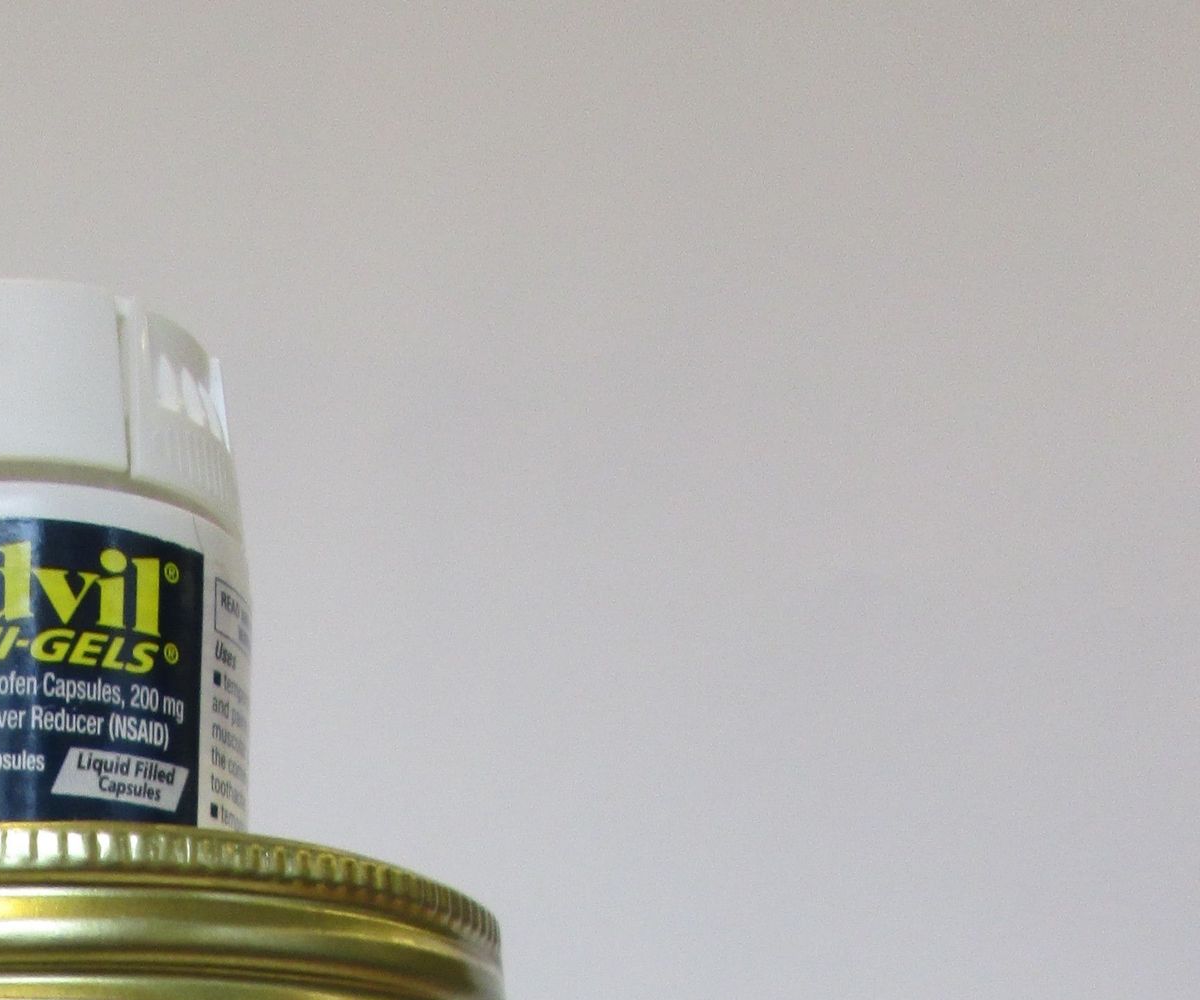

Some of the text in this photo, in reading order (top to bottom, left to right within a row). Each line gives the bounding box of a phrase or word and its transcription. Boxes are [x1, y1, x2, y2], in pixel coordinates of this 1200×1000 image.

[214, 640, 237, 670] Uses
[42, 671, 126, 710] Capsules,
[130, 683, 159, 712] 200
[163, 695, 185, 724] mg
[31, 704, 105, 736] Reducer
[108, 712, 170, 751] (NSAID)
[76, 752, 176, 786] Liquid Filled
[98, 775, 162, 803] Capsules
